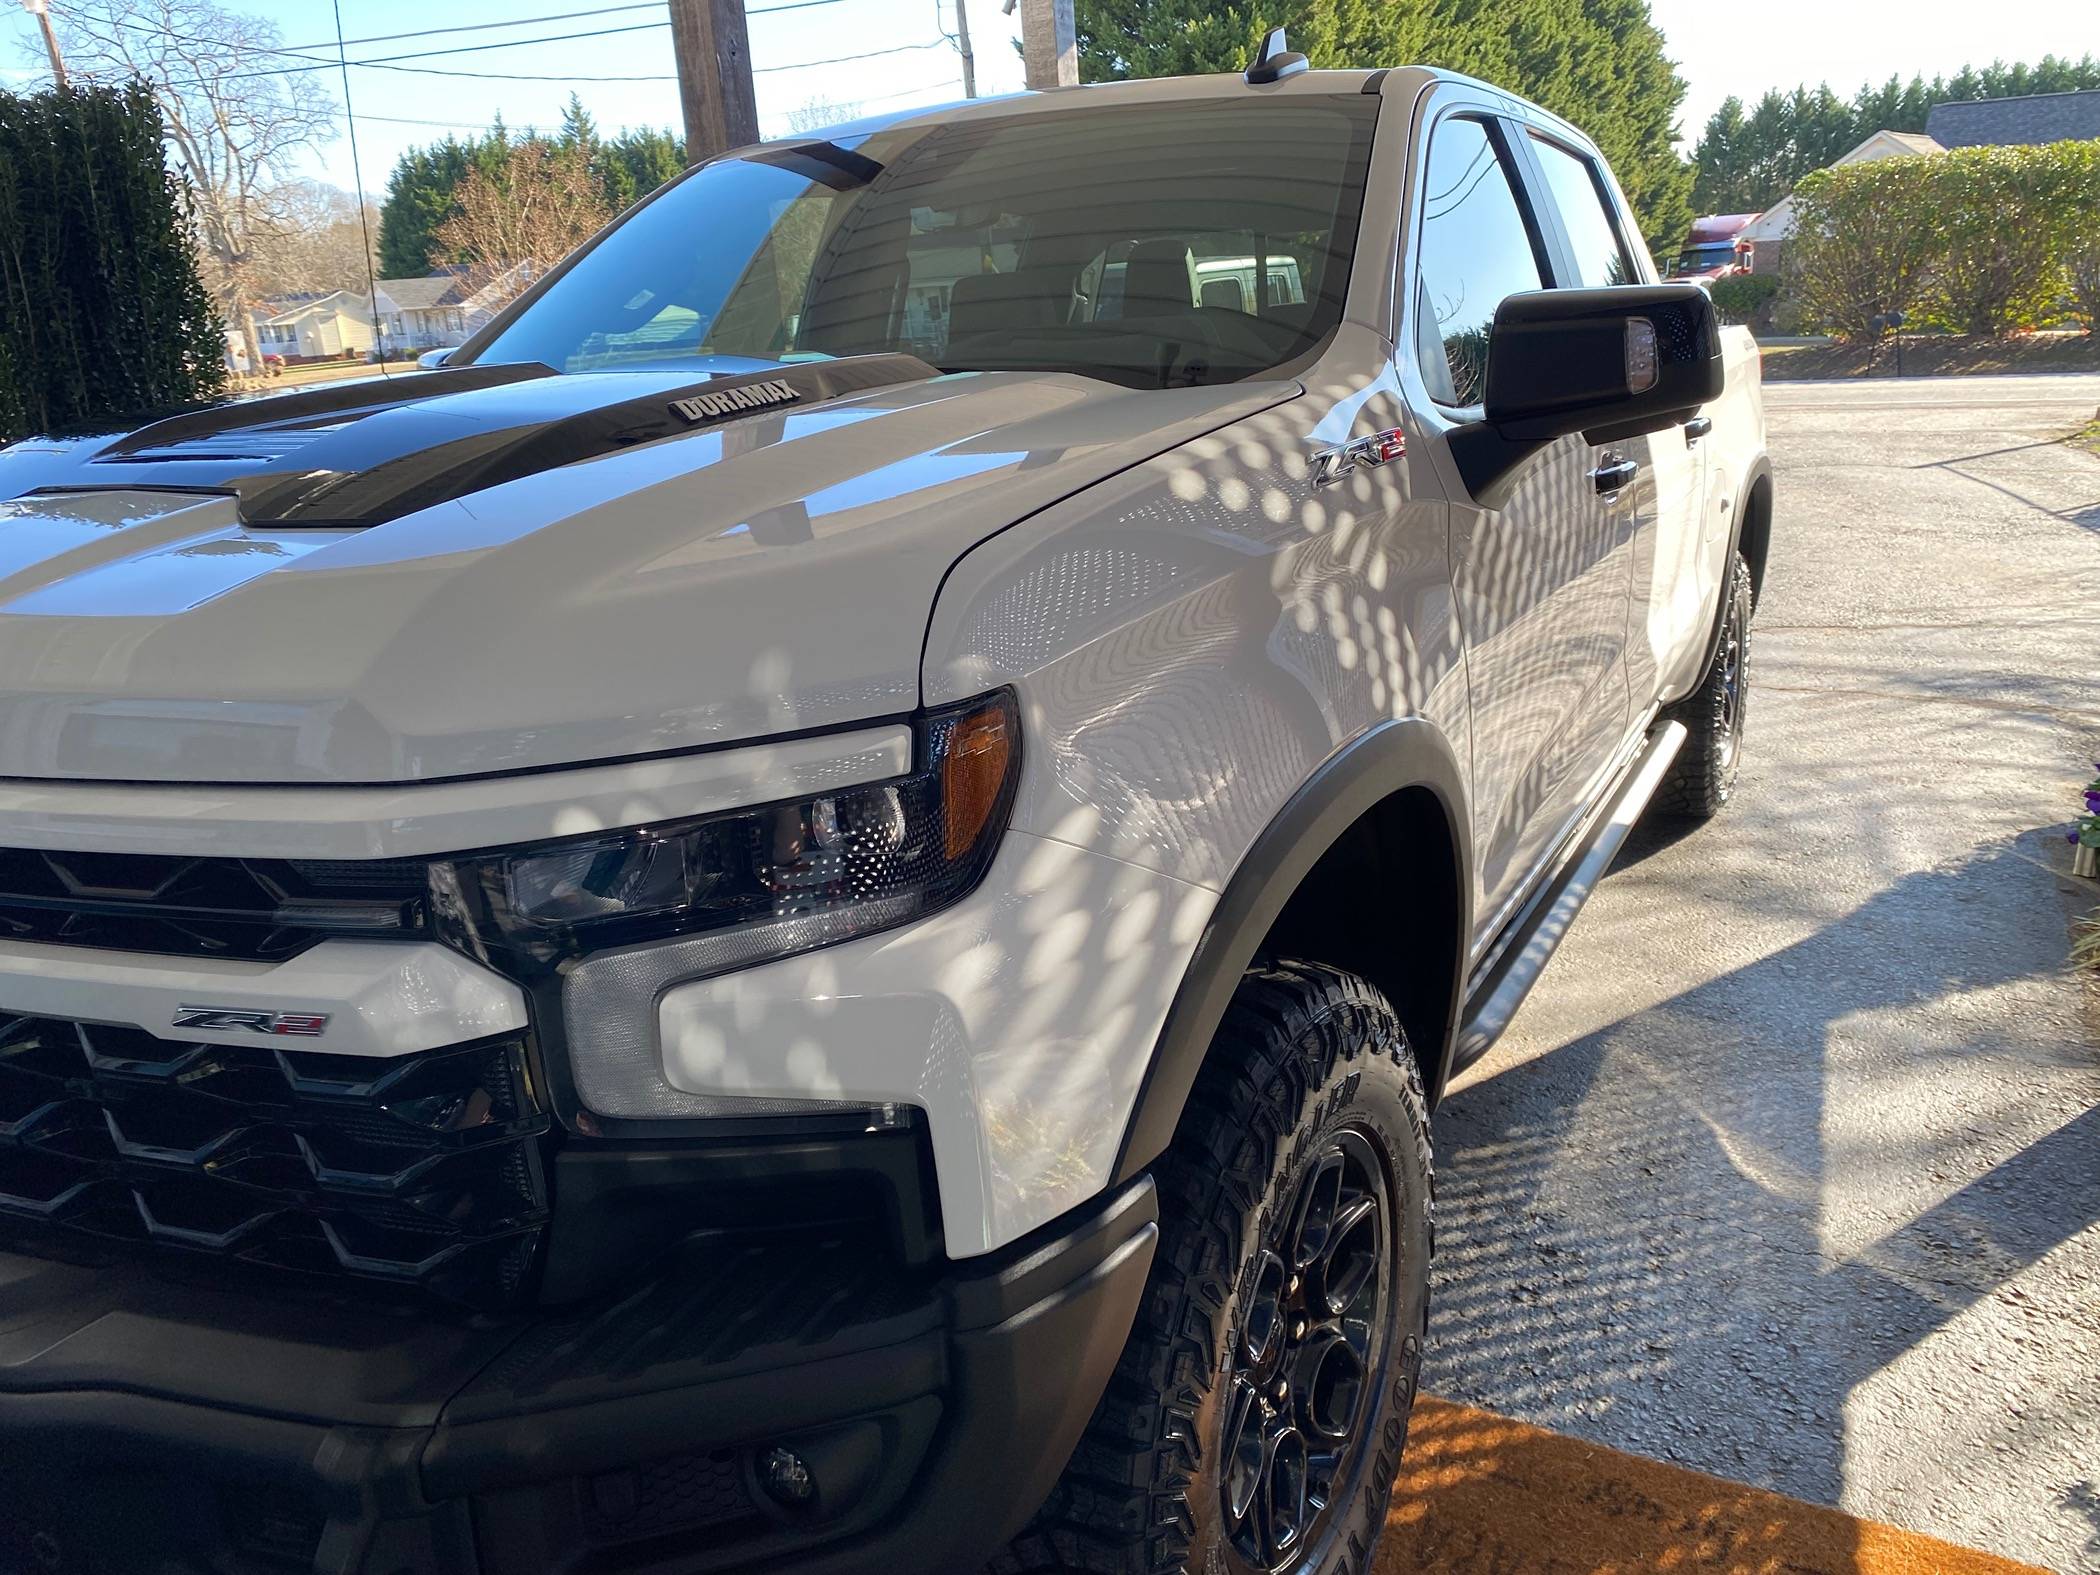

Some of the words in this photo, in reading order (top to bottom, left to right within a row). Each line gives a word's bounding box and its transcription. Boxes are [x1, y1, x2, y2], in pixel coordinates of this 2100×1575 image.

[668, 379, 801, 424] DURAMAX
[1304, 427, 1407, 490] ZR2
[172, 1003, 331, 1037] ZR2
